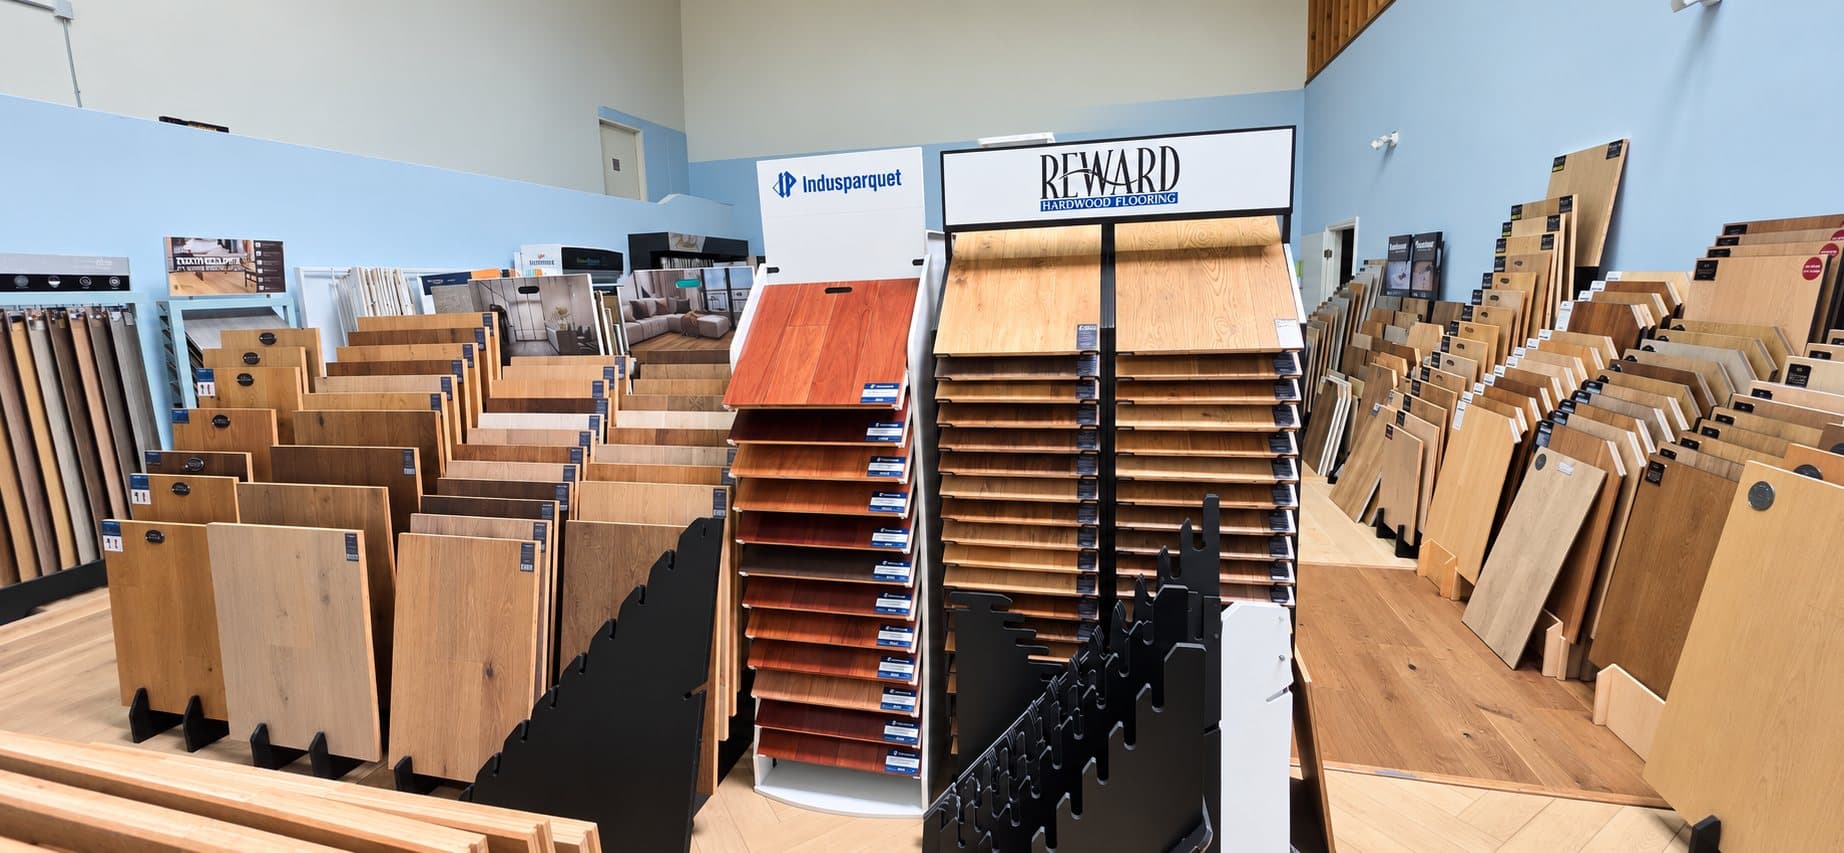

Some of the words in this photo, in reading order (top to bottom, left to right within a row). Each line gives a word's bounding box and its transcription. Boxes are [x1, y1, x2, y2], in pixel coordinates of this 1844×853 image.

[802, 169, 902, 194] Indusparquet
[1040, 145, 1180, 199] REWARD
[1042, 198, 1111, 211] HARDWOOD
[1115, 193, 1177, 206] FLOORING
